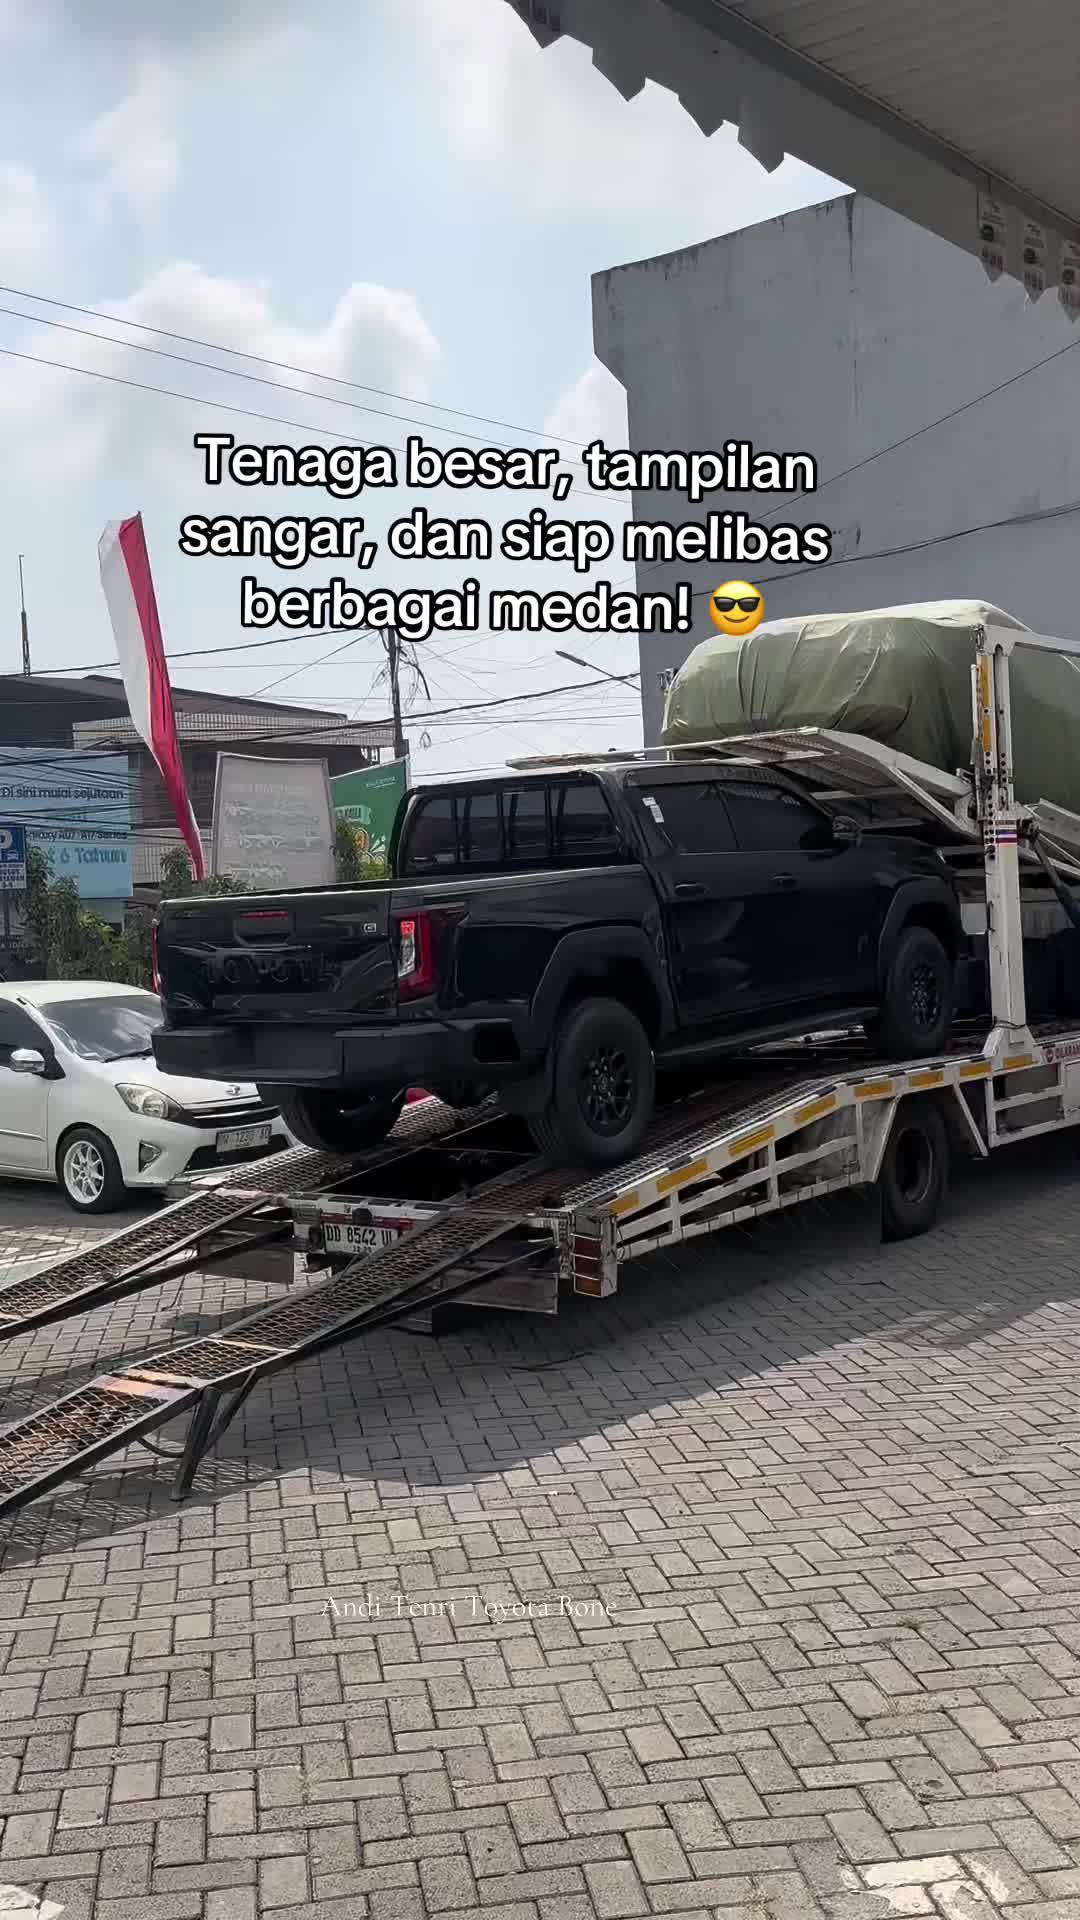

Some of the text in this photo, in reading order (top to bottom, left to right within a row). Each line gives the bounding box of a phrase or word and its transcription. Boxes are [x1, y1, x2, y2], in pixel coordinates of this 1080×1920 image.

[2, 785, 124, 801] Di sini mulai sejutaan
[75, 847, 128, 863] Tahun
[326, 1224, 341, 1242] DD
[347, 1226, 377, 1246] 8542
